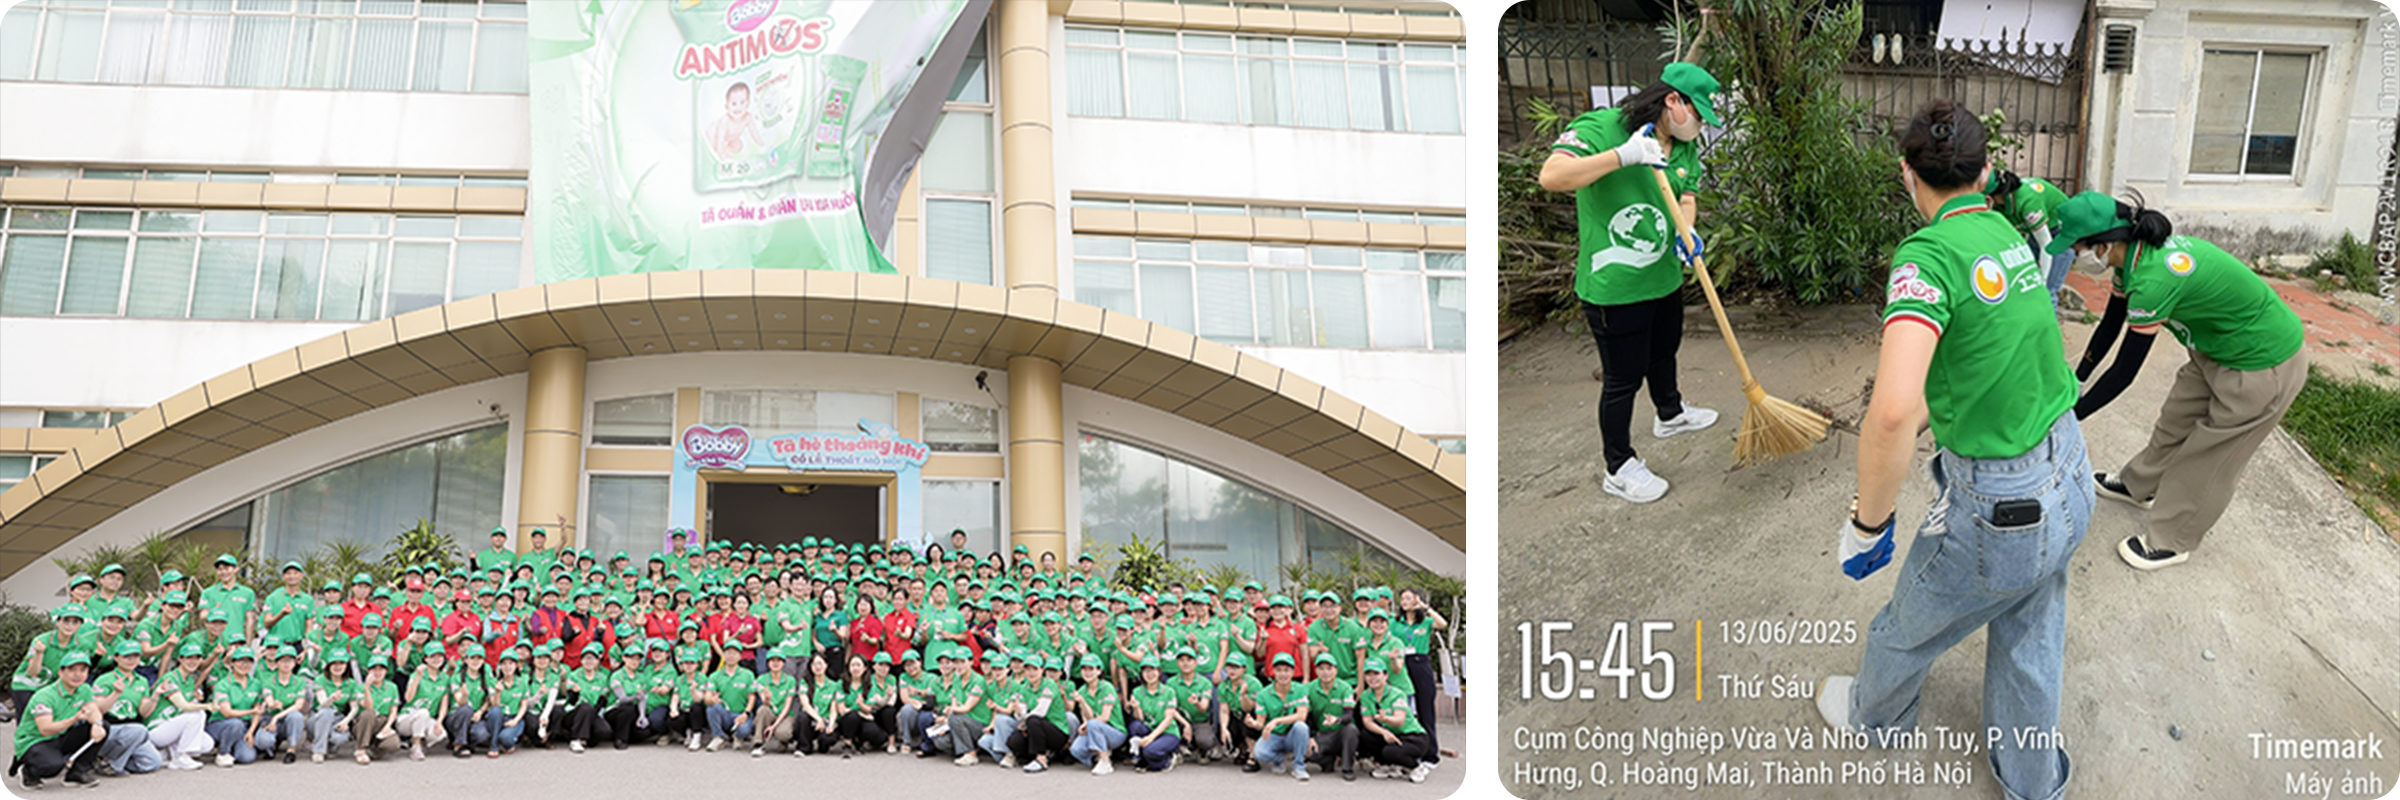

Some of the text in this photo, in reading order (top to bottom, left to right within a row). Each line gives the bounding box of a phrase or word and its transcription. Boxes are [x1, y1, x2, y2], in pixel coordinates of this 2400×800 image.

[680, 18, 822, 75] ANTIMOS
[772, 437, 796, 454] Tã
[824, 435, 891, 456] thoáng
[893, 441, 927, 461] khí
